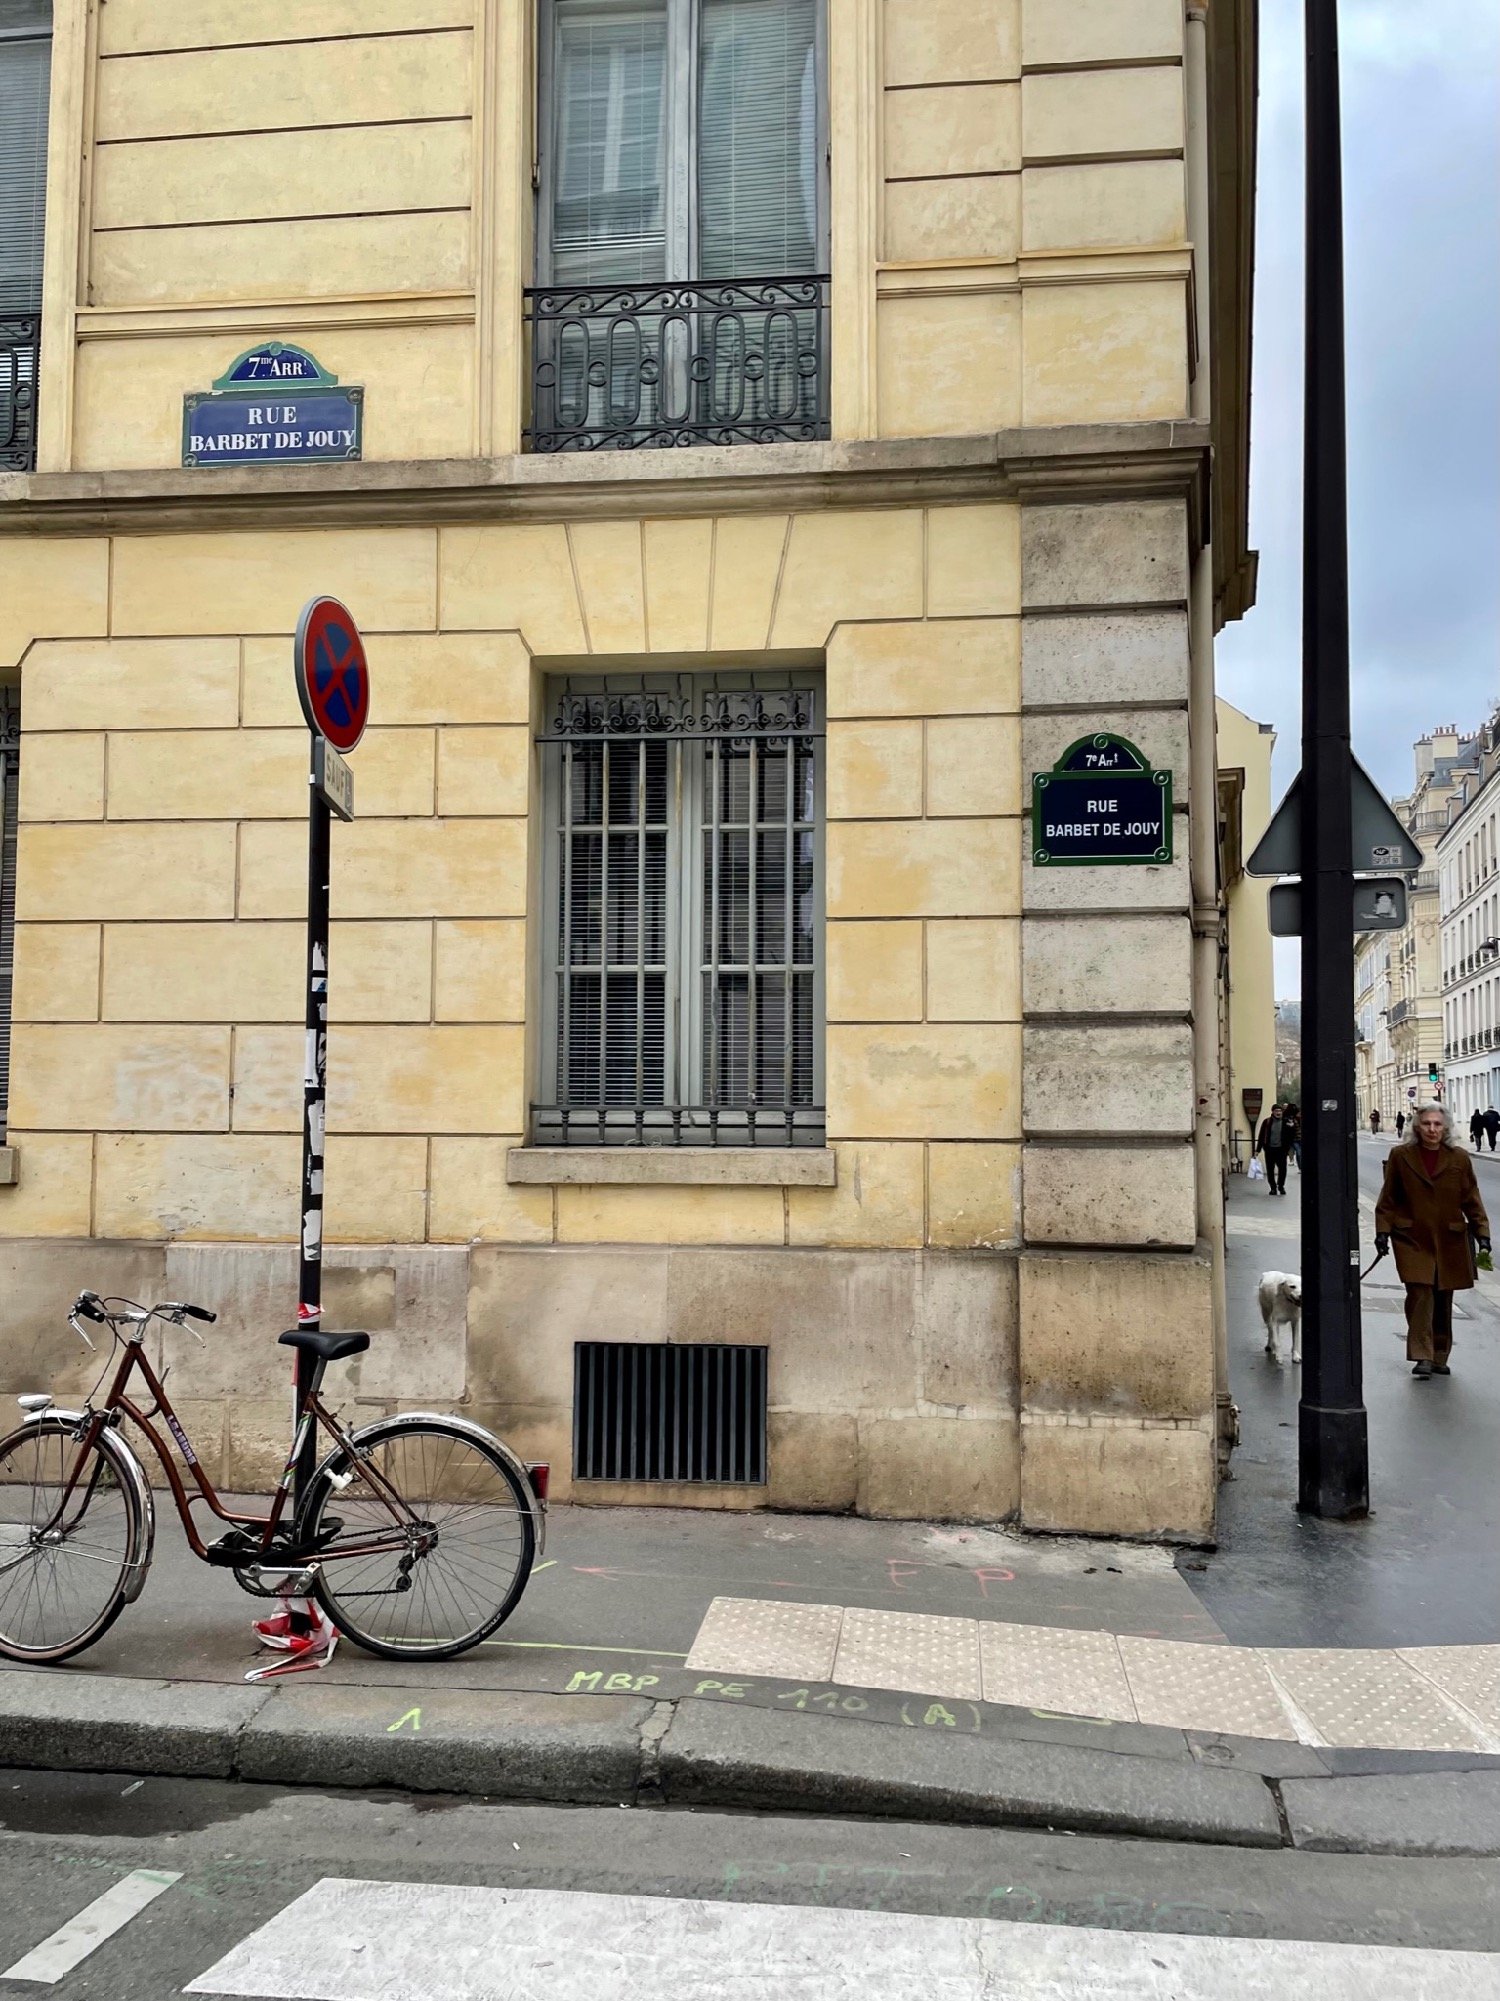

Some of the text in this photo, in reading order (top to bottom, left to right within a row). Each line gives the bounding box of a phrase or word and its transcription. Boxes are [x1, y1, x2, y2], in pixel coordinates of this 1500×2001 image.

[248, 406, 297, 425] RUE
[190, 430, 355, 452] BARBET DE JOUY
[1087, 799, 1118, 813] RUE
[1046, 822, 1160, 837] BARBET DE JOUY
[564, 1671, 660, 1692] MBP
[693, 1679, 755, 1698] PE
